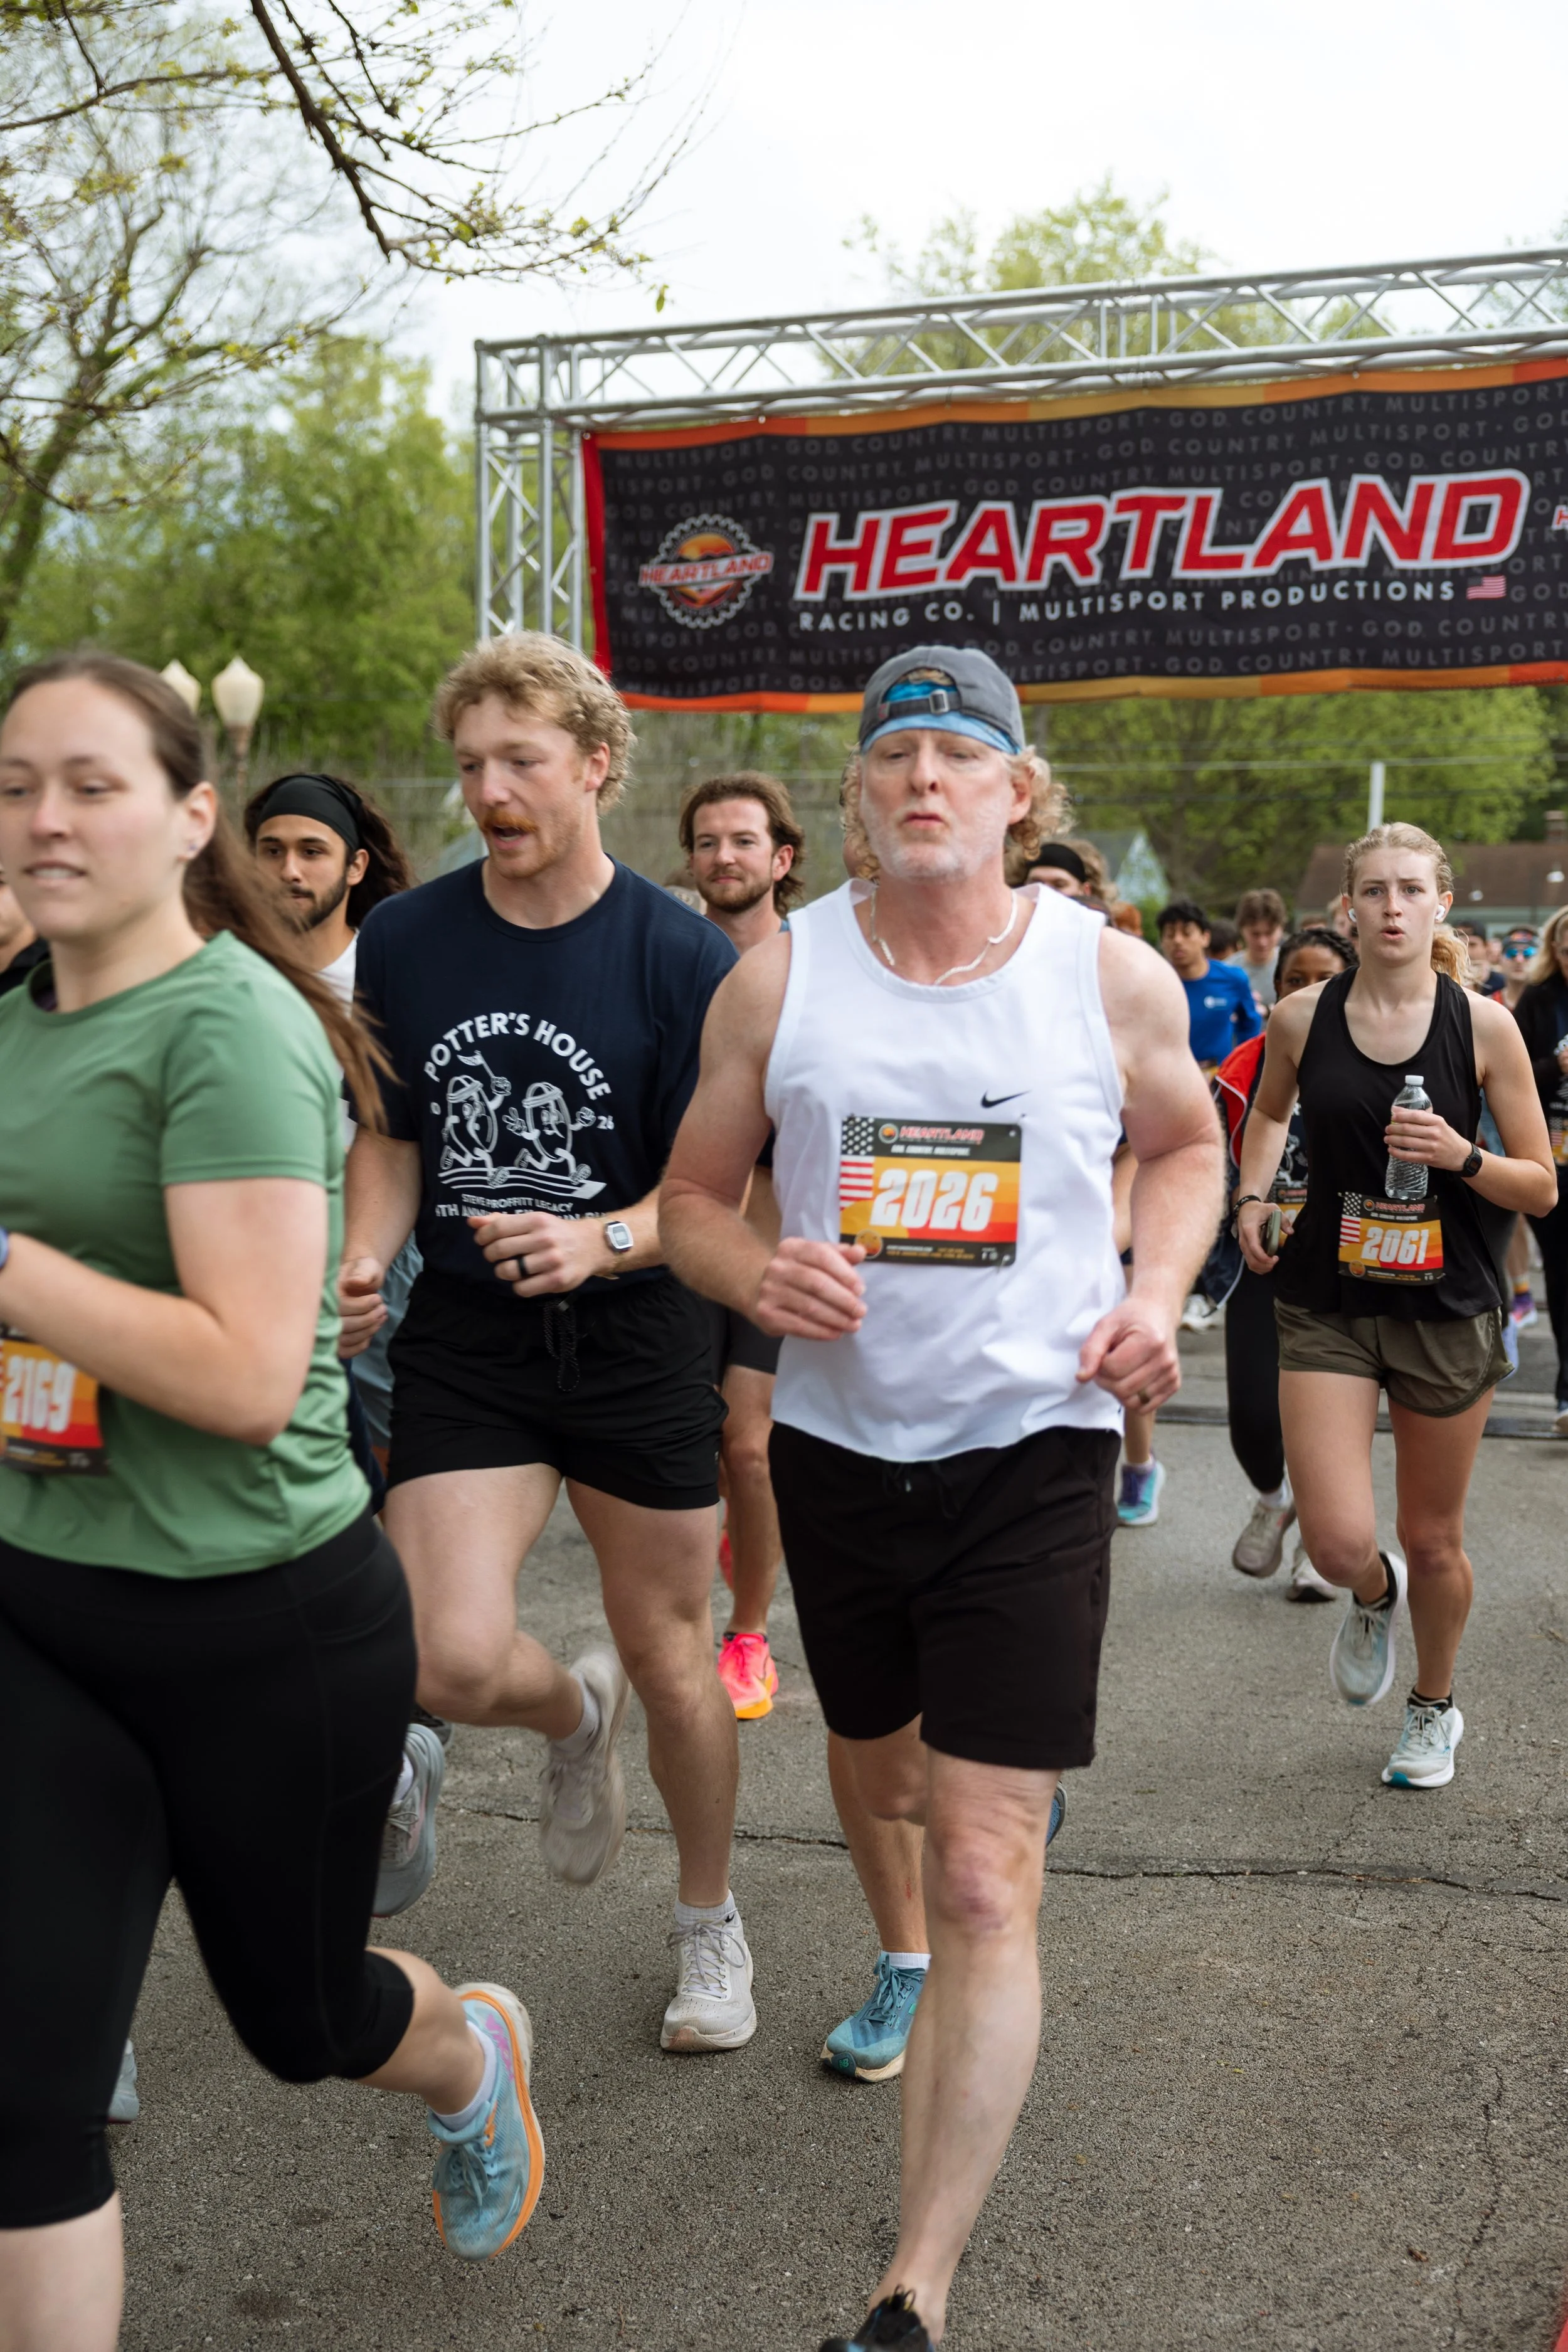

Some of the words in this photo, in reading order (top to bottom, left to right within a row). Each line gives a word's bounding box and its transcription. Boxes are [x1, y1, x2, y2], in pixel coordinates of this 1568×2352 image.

[982, 411, 1147, 442] MULTISPORT
[1385, 382, 1567, 413] MULTISPORT
[1309, 420, 1487, 445] MULTISPORT
[1167, 454, 1339, 482] MULTISPORT
[792, 468, 1531, 601] HEARTLAND
[639, 551, 774, 586] HEARTLAND
[799, 606, 910, 632] RACING
[924, 601, 975, 622] CO.
[1019, 590, 1205, 622] MULTISPORT
[1221, 580, 1455, 611] PRODUCTIONS
[1165, 620, 1338, 647] MULTISPORT
[1382, 639, 1564, 666] MULTISPORT
[423, 1012, 531, 1083] POTTER'S
[532, 1019, 612, 1101] HOUSE
[534, 1198, 574, 1212] LEGACY
[869, 1168, 999, 1232] 2026
[1360, 1226, 1429, 1265] 2061
[3, 1354, 77, 1434] 2169
